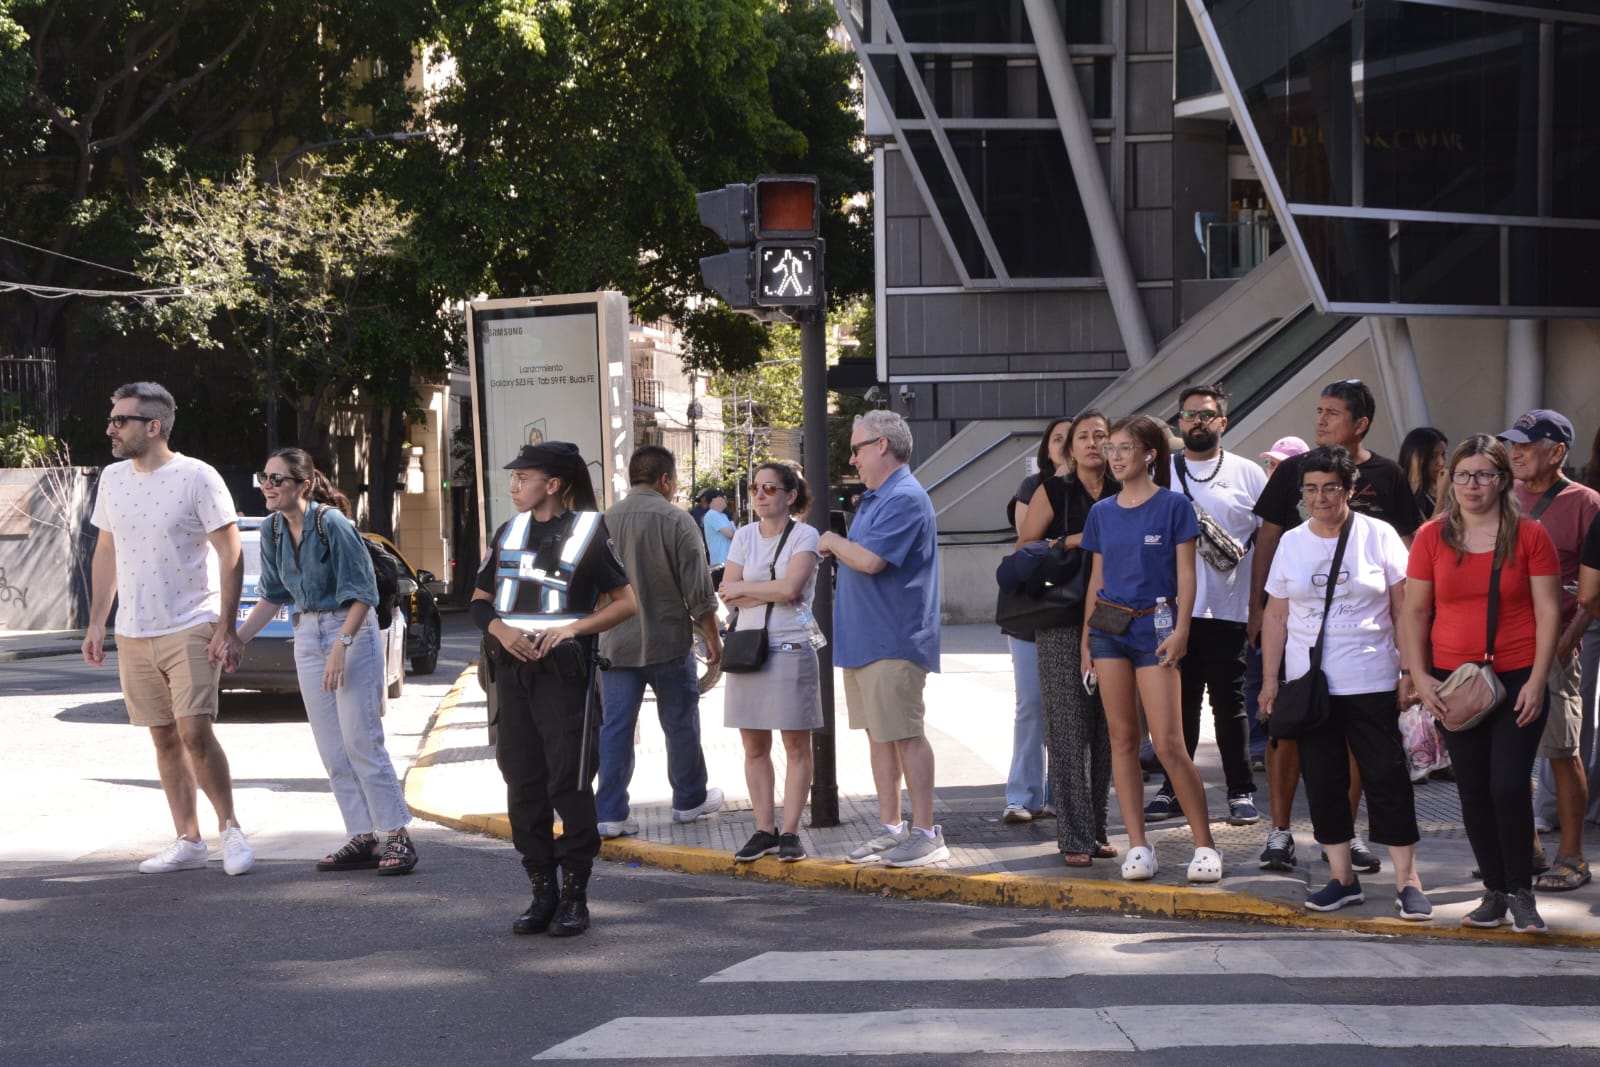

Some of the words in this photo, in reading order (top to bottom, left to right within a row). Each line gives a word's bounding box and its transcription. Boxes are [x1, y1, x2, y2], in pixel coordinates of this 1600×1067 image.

[488, 327, 523, 336] SAMSUNG
[519, 364, 563, 373] Lanzamiento
[490, 379, 515, 389] Galaxy
[515, 377, 526, 386] S23
[527, 377, 534, 386] FE
[538, 376, 550, 385] Tab
[551, 376, 559, 384] S9
[559, 375, 567, 384] FE
[569, 375, 586, 384] Buds
[587, 374, 595, 383] FE
